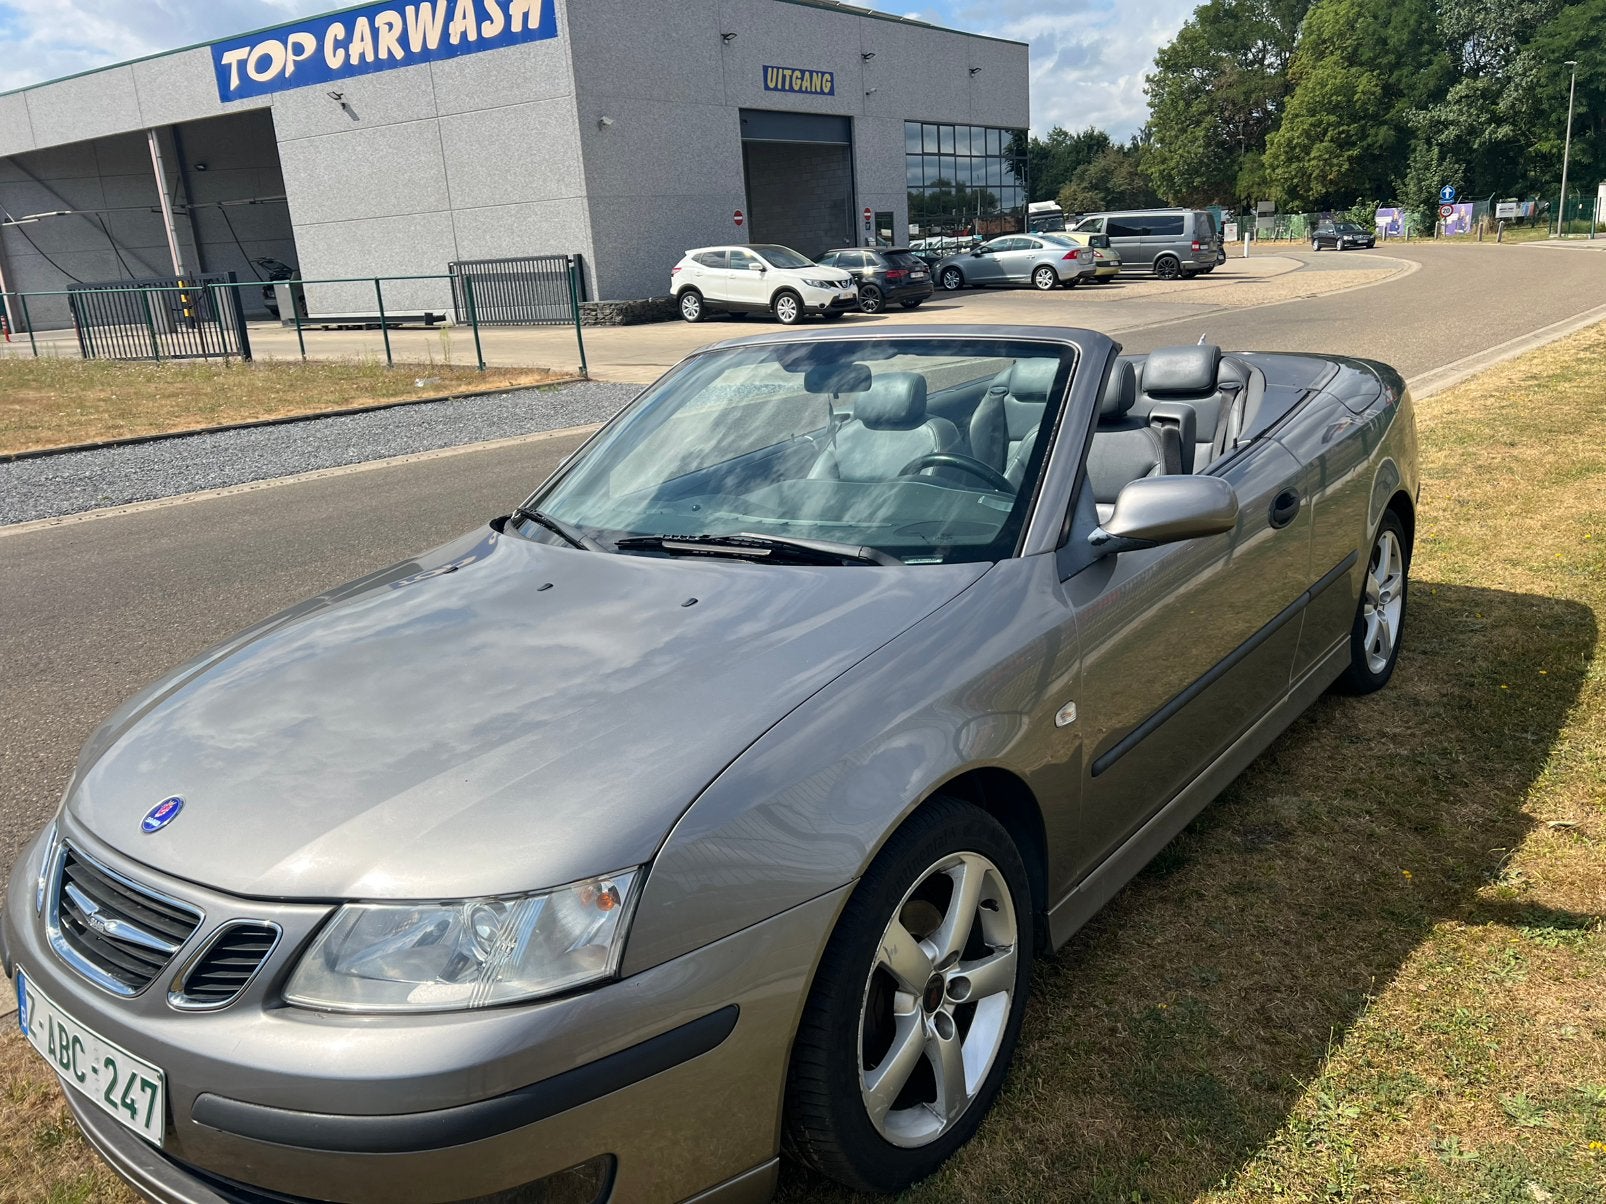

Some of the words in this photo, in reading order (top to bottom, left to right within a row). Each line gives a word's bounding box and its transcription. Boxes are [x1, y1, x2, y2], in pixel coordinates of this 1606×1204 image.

[220, 32, 317, 91] TOP
[323, 0, 542, 69] CARWASH
[767, 67, 831, 93] UITGANG
